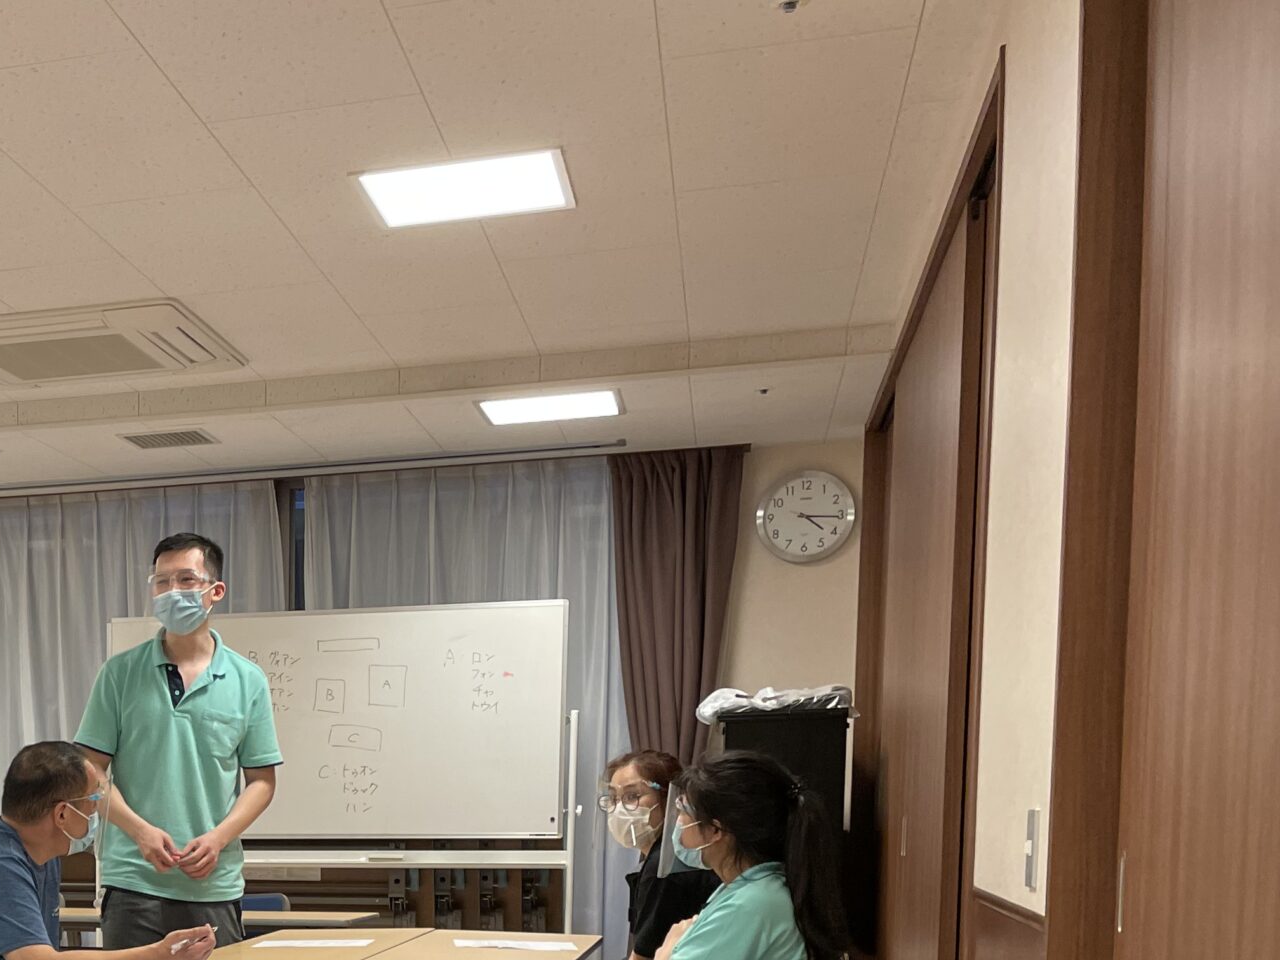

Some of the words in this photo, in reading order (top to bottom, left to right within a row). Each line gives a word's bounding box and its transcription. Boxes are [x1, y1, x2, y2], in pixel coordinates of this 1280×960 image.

[801, 480, 812, 490] 12
[786, 486, 794, 496] 11
[773, 498, 784, 508] 10
[832, 494, 839, 504] 2
[767, 514, 774, 523] 9
[837, 510, 844, 520] 3
[772, 529, 779, 539] 8
[830, 526, 837, 535] 4
[785, 539, 792, 549] 7
[800, 543, 808, 552] 6
[817, 538, 824, 547] 5
[382, 679, 392, 689] A
[325, 687, 335, 701] B
[347, 732, 360, 743] C
